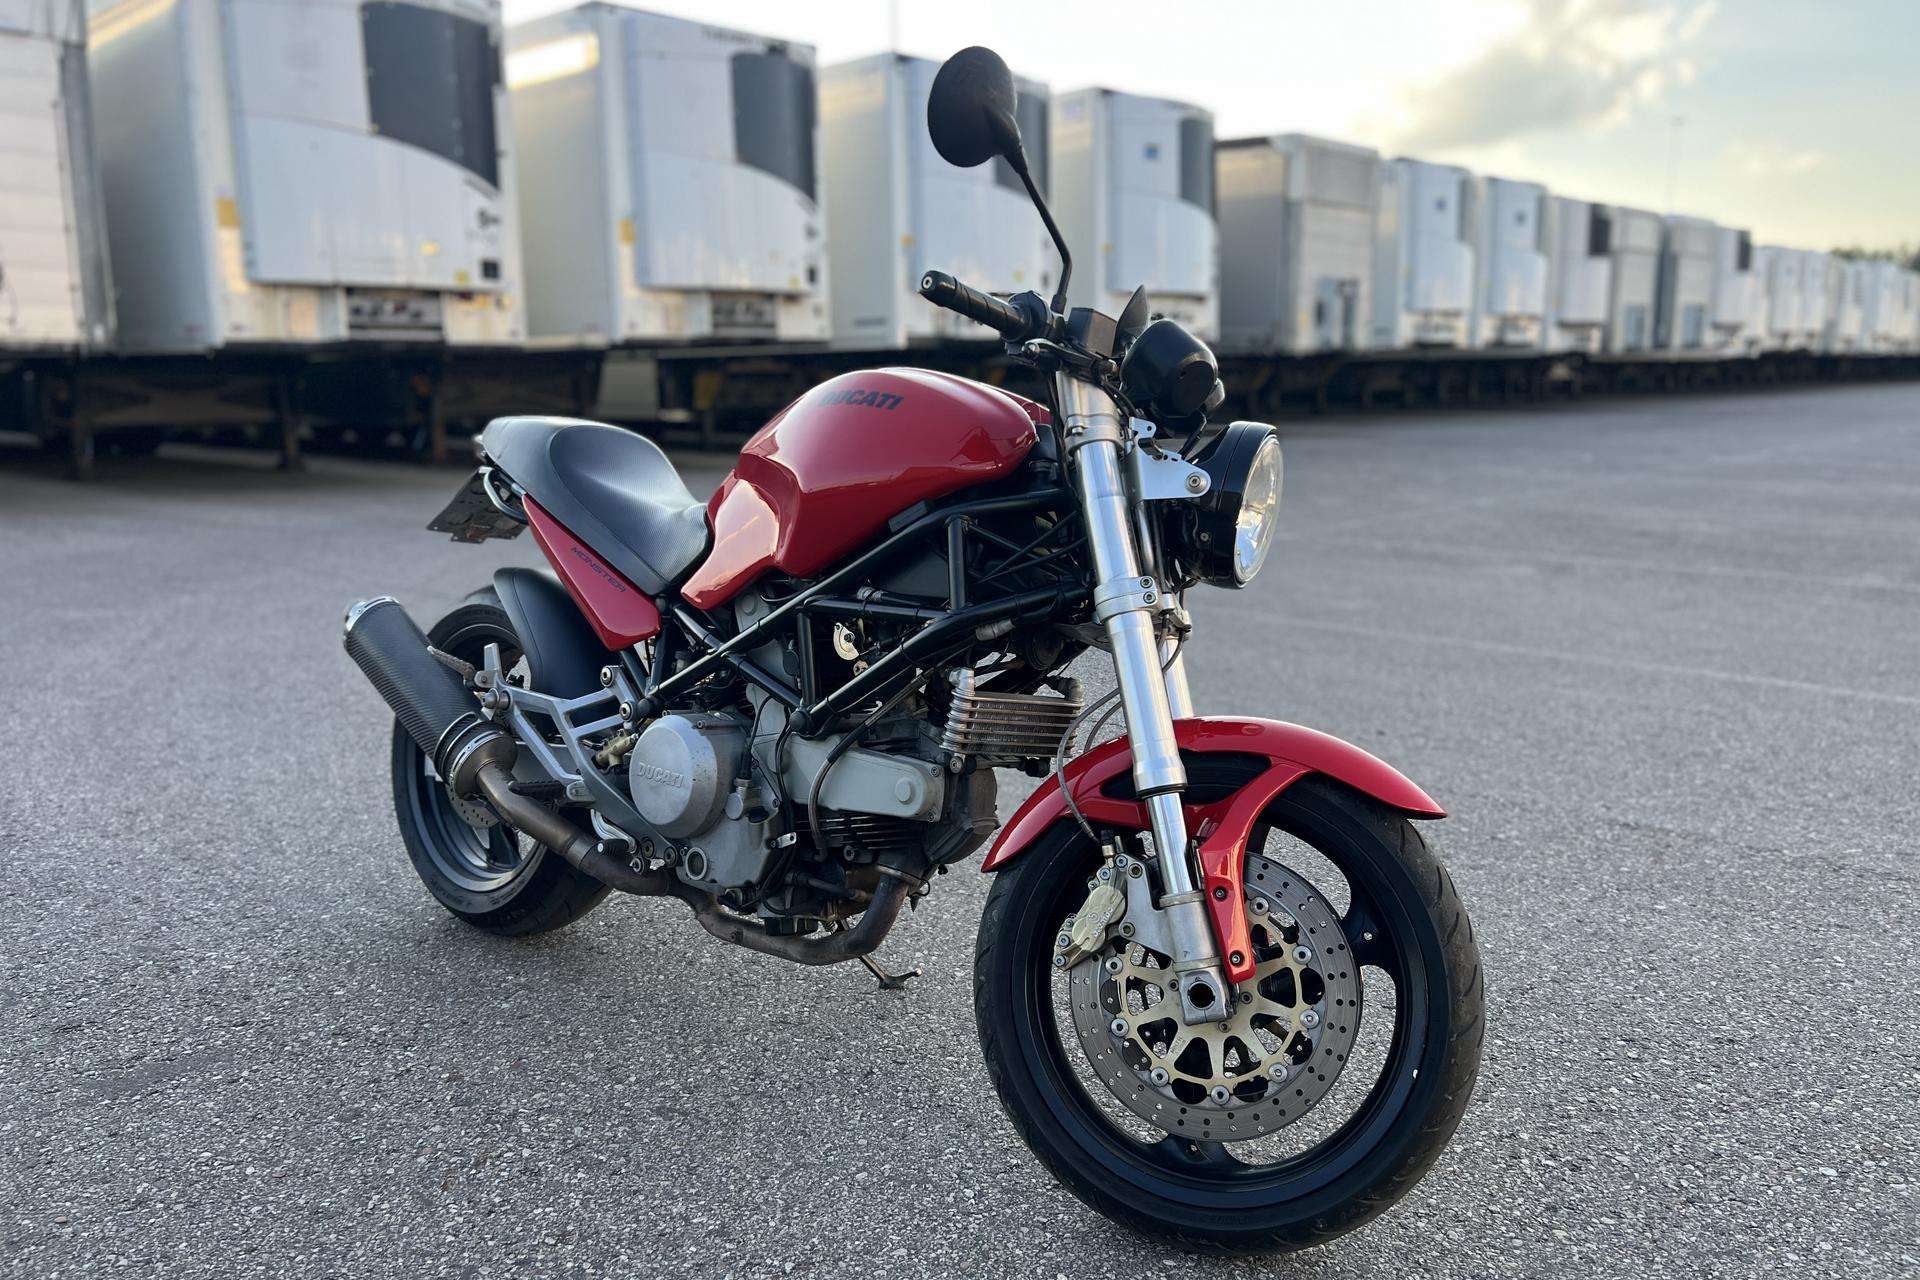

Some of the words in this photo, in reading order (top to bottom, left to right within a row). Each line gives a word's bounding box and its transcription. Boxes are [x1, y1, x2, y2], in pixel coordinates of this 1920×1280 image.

[819, 389, 905, 410] DUCATI
[571, 546, 627, 593] MONSTER
[637, 761, 685, 789] DUCATI
